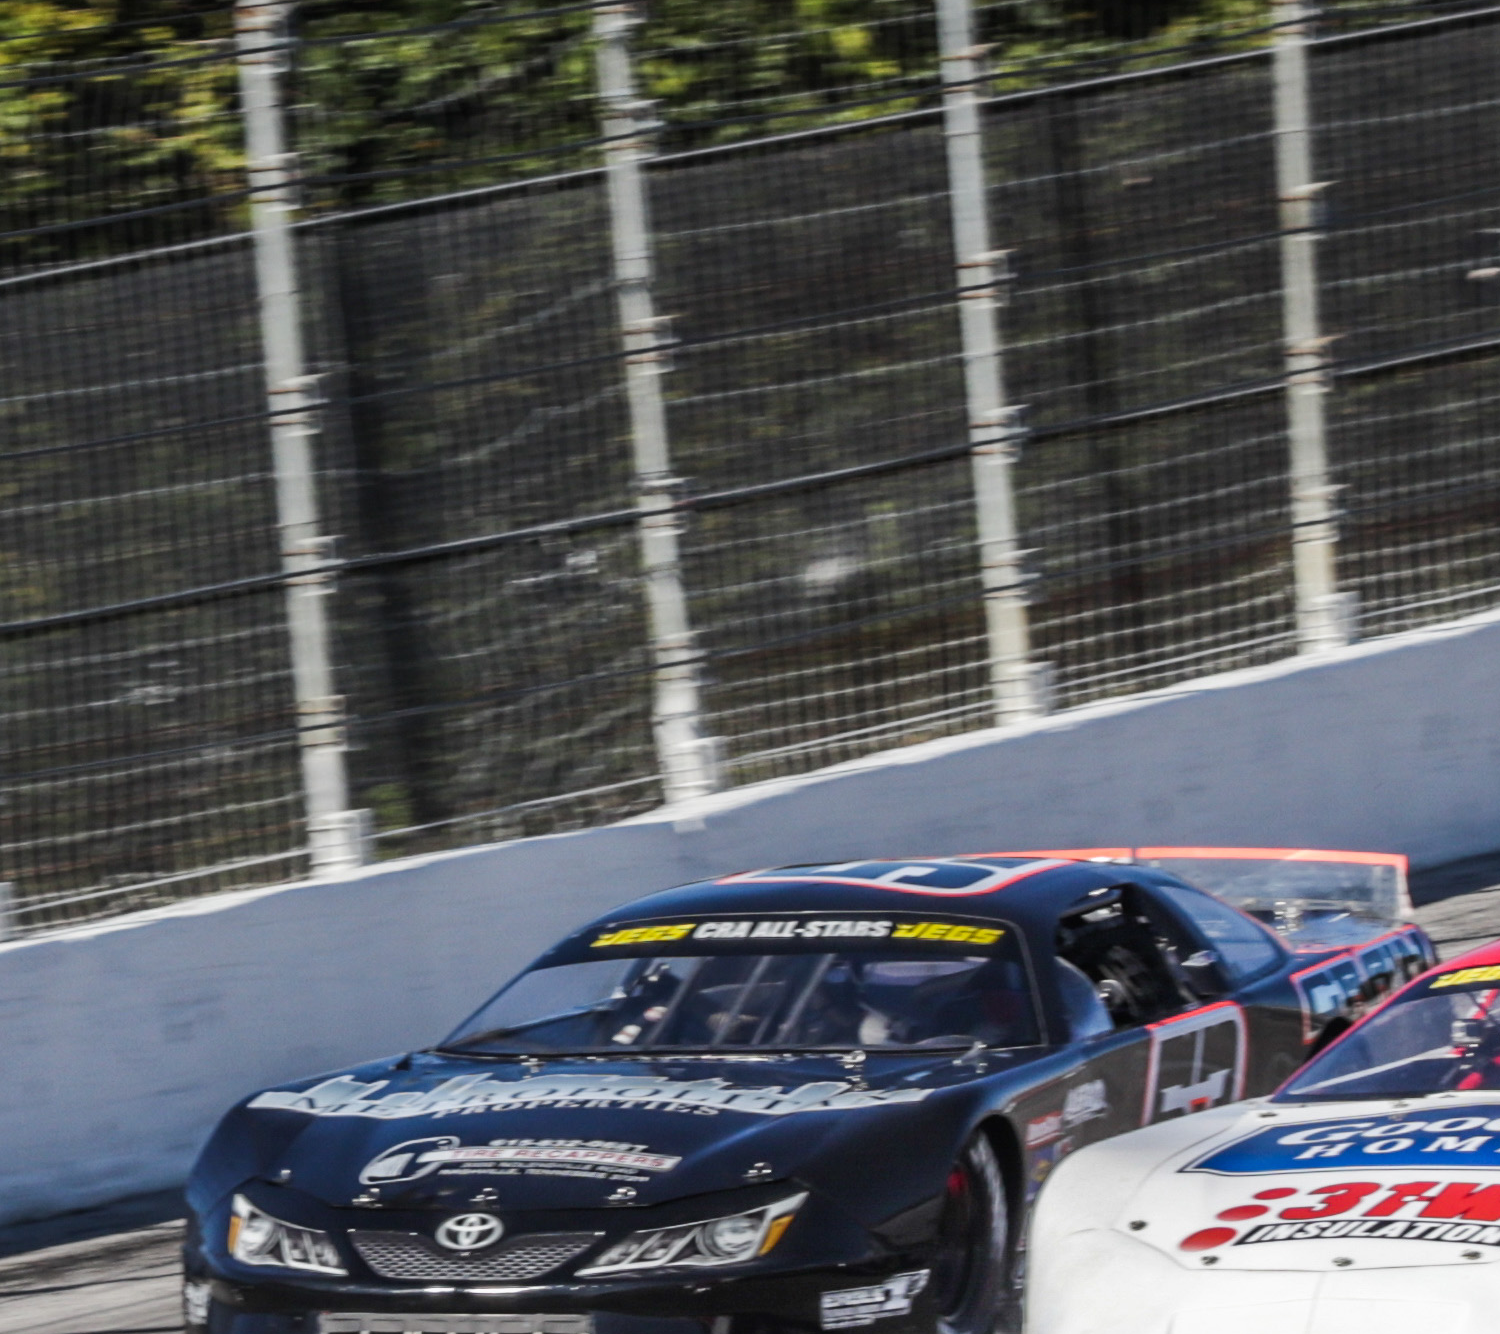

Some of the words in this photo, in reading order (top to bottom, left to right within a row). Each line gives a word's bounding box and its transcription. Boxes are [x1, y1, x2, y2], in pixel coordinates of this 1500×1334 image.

[591, 924, 696, 947] JEGS
[694, 921, 748, 939] CRA
[749, 920, 892, 938] ALL-STARS
[892, 923, 1005, 945] JEGS
